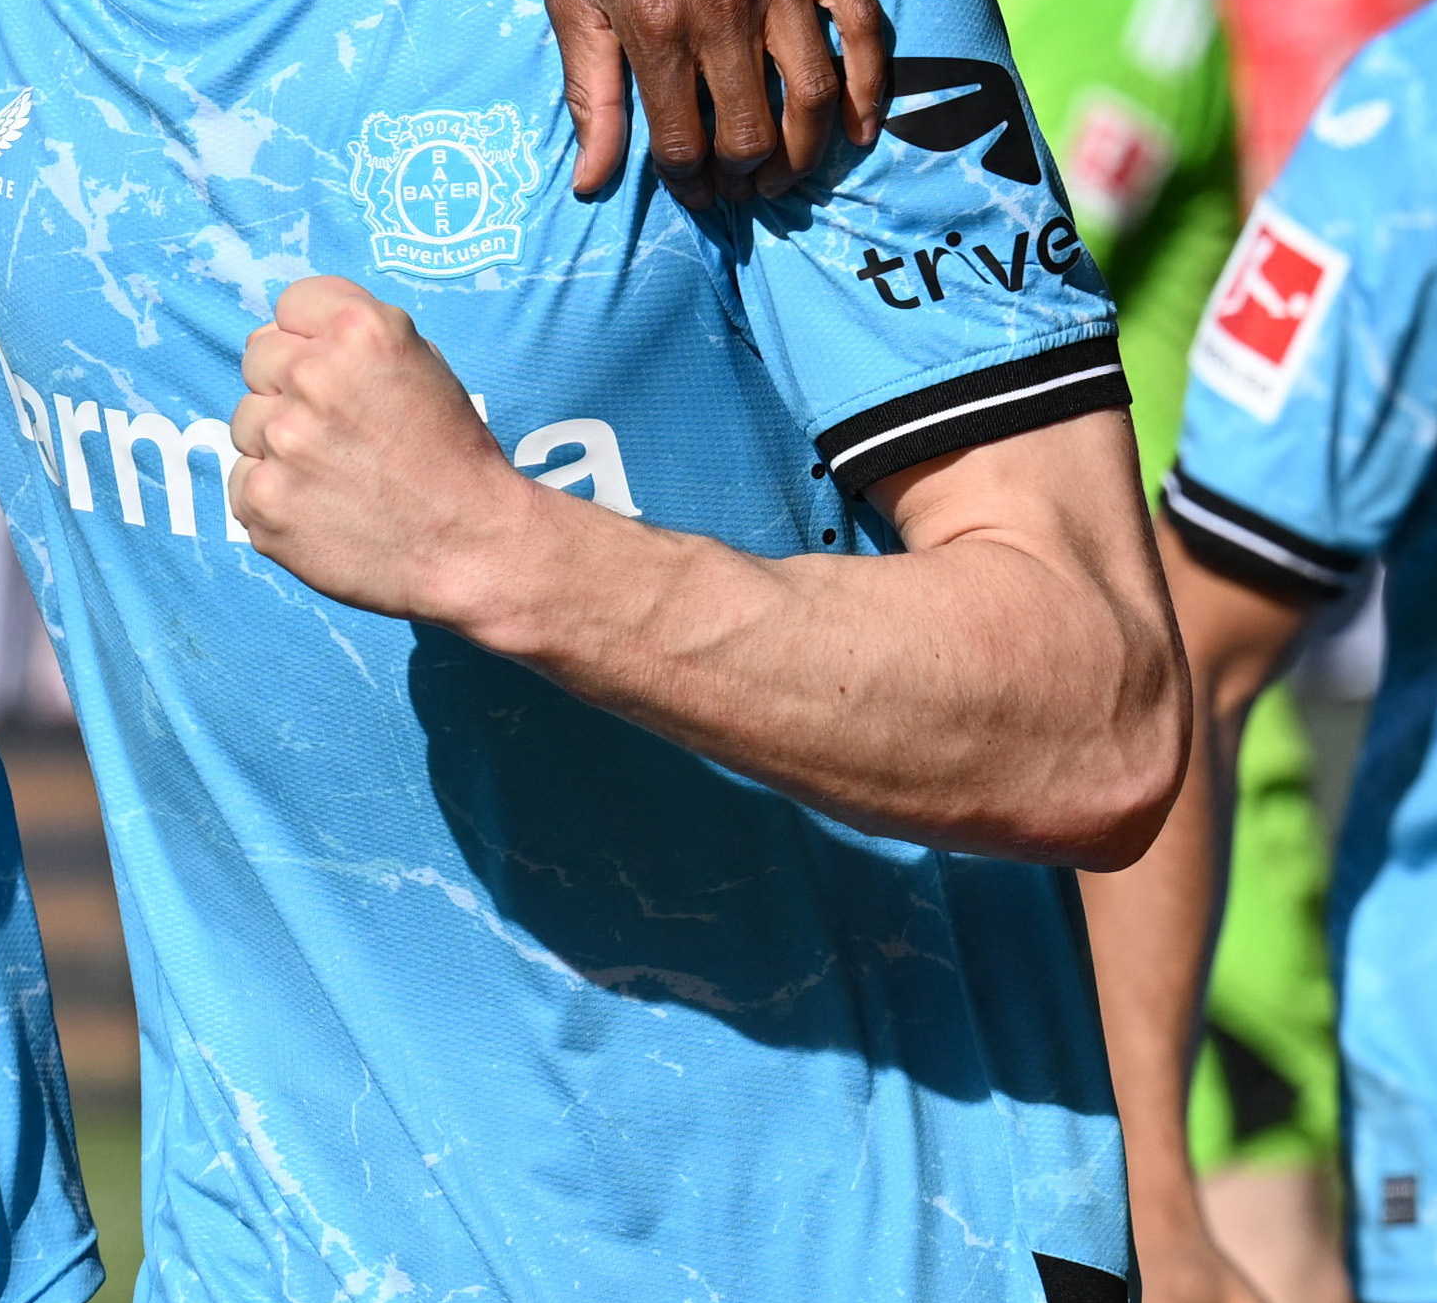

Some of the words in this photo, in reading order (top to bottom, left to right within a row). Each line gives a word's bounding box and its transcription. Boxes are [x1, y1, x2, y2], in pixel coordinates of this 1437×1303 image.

[416, 119, 461, 137] 1904
[403, 182, 480, 201] BAYER
[432, 149, 451, 235] BAYER
[383, 236, 507, 265] Leverkusen
